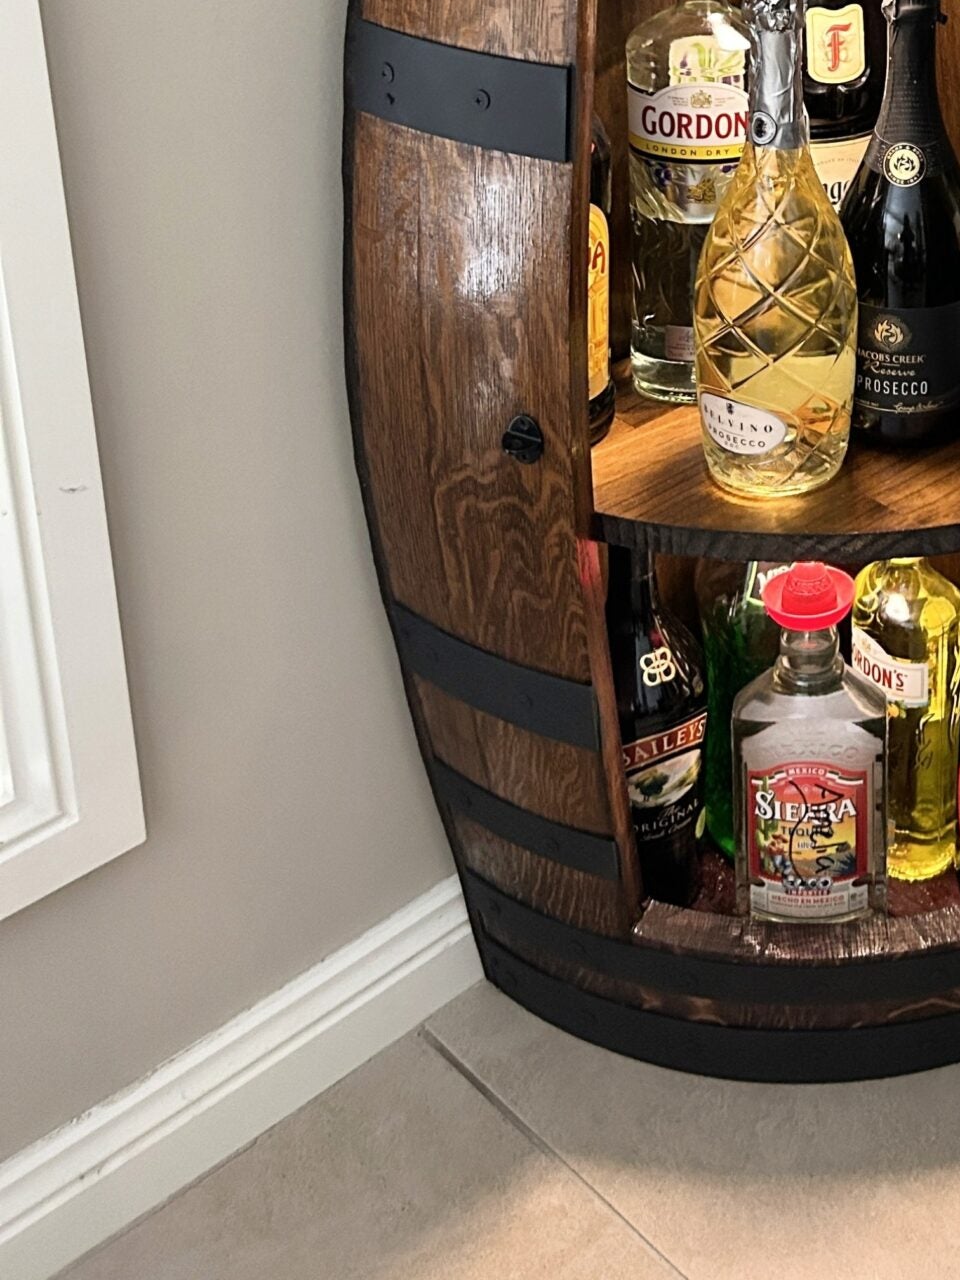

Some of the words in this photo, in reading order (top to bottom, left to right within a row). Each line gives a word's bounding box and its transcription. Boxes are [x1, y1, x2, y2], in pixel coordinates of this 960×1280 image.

[645, 142, 698, 157] LONDON
[706, 146, 730, 157] DRY
[892, 354, 925, 365] CREEK
[856, 374, 929, 396] PROSECCO
[708, 422, 767, 448] PROSECCO
[854, 649, 904, 688] RDON'S
[787, 767, 826, 776] MEXICO
[755, 789, 857, 824] SIERRA
